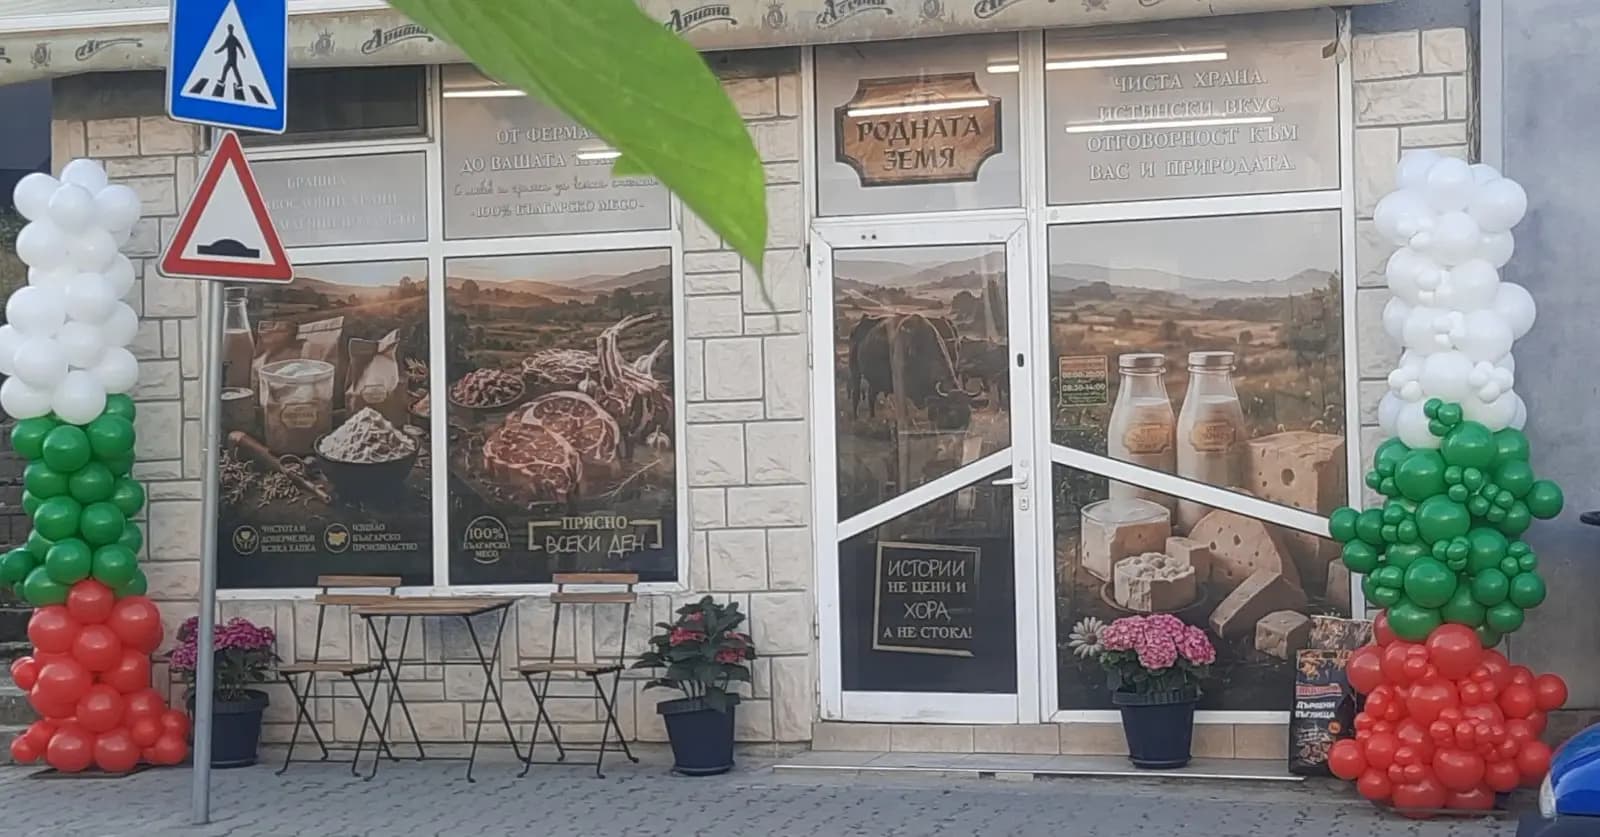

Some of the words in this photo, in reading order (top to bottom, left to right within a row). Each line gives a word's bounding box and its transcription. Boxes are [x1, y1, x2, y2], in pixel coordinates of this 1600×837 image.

[1113, 74, 1183, 93] ЧИСТА
[1193, 69, 1268, 89] ХРАНА.
[1098, 101, 1214, 122] ИСТИНСКИ
[1224, 96, 1285, 115] ВКУС.
[496, 129, 520, 145] ОТ
[526, 125, 595, 143] ФЕРМА
[856, 114, 981, 146] РОДНАТА
[1087, 127, 1239, 153] ОТГОВОРНОСТ
[1249, 124, 1298, 143] КЪМ
[460, 157, 485, 176] ДО
[491, 153, 566, 172] ВАШАТА
[883, 145, 955, 171] ЗЕМЯ
[1089, 162, 1129, 182] ВАС
[1140, 162, 1155, 178] И
[1166, 153, 1296, 177] ПРИРОДАТА.
[470, 527, 504, 540] 100%
[561, 516, 628, 530] ПРЯСНО
[546, 535, 600, 553] ВСЕКИ
[608, 534, 645, 559] ДЕН
[888, 559, 965, 577] ИСТОРИИ
[887, 581, 908, 593] НЕ
[912, 581, 951, 595] ЦЕНИ
[956, 582, 966, 593] И
[904, 600, 951, 621] ХОРА
[883, 627, 893, 638] А
[897, 627, 917, 638] НЕ
[920, 626, 973, 639] СТОКА!
